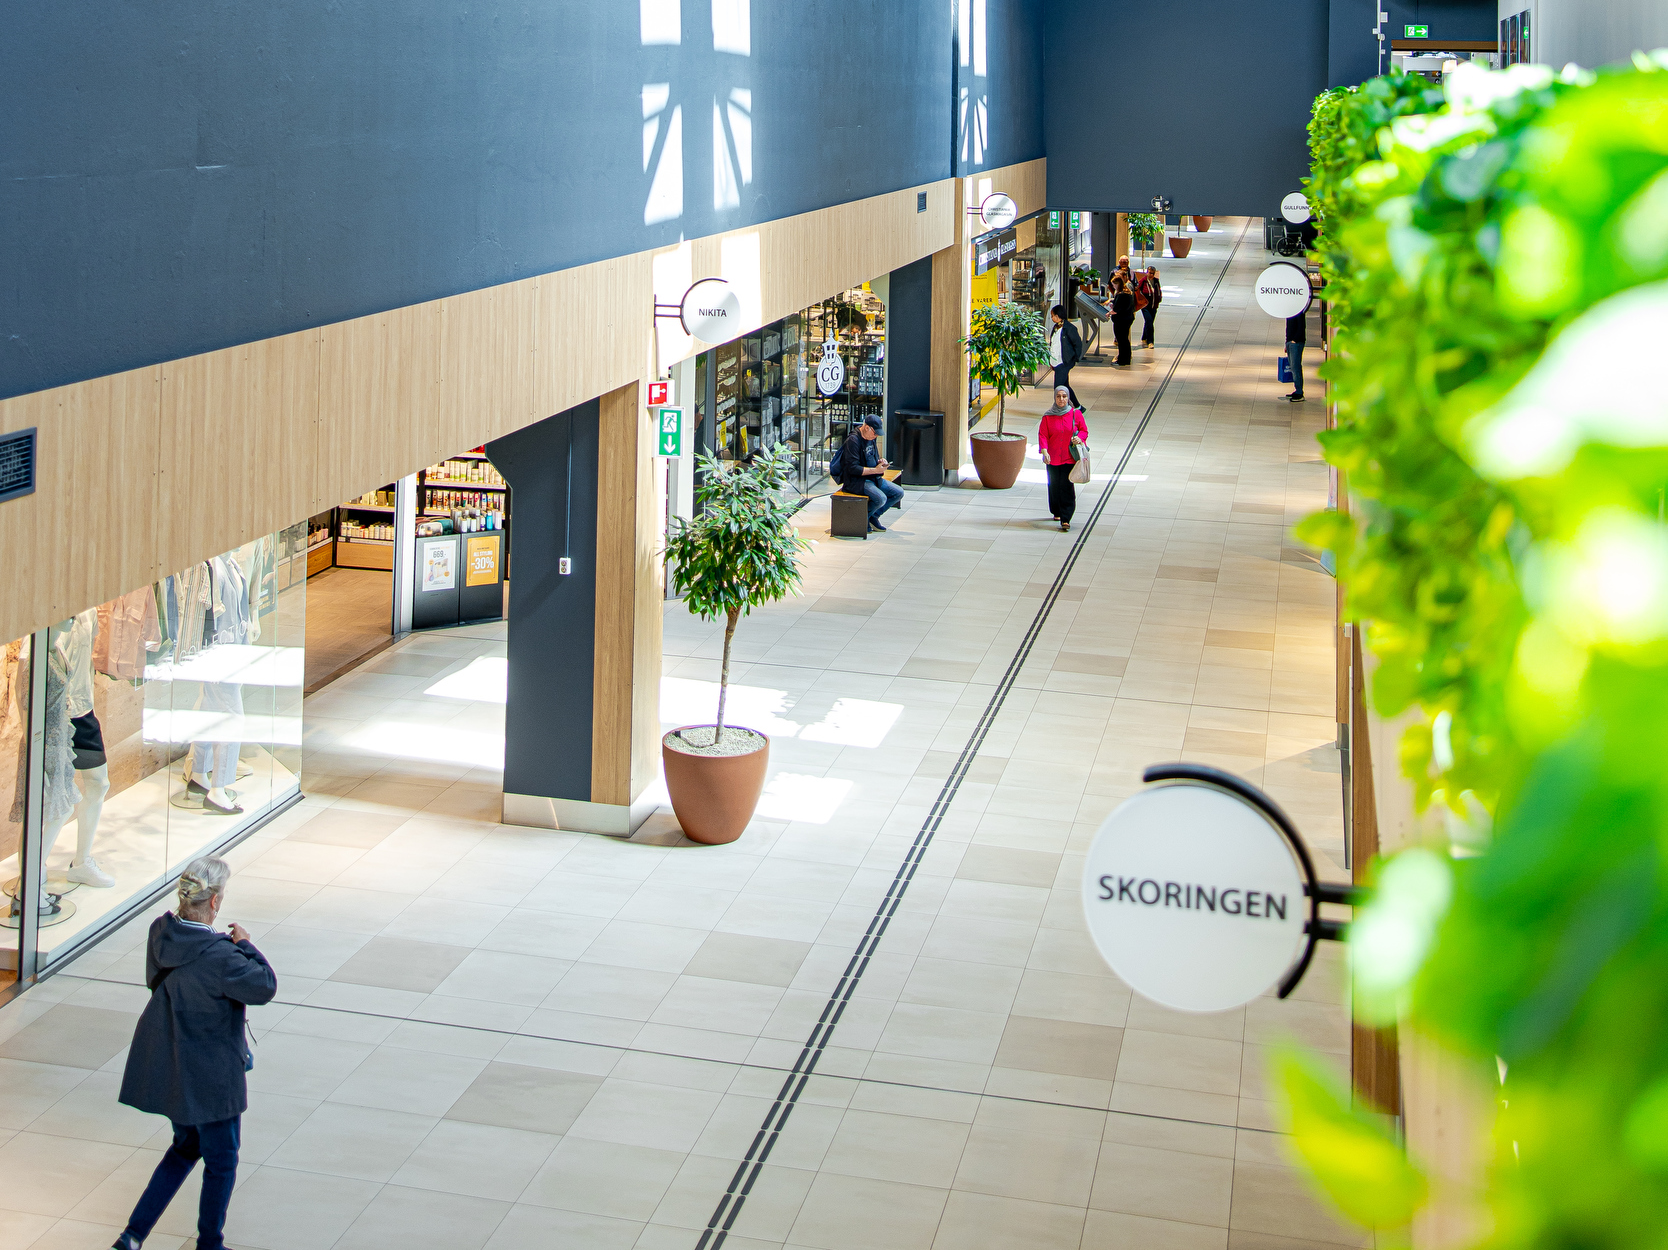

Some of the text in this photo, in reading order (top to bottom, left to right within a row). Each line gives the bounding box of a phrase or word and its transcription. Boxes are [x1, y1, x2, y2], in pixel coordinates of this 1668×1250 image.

[1260, 286, 1304, 296] SKINTONIC
[698, 308, 727, 317] NIKITA
[821, 365, 840, 382] CG
[471, 556, 495, 570] -30%
[1098, 874, 1287, 920] SKORINGEN
